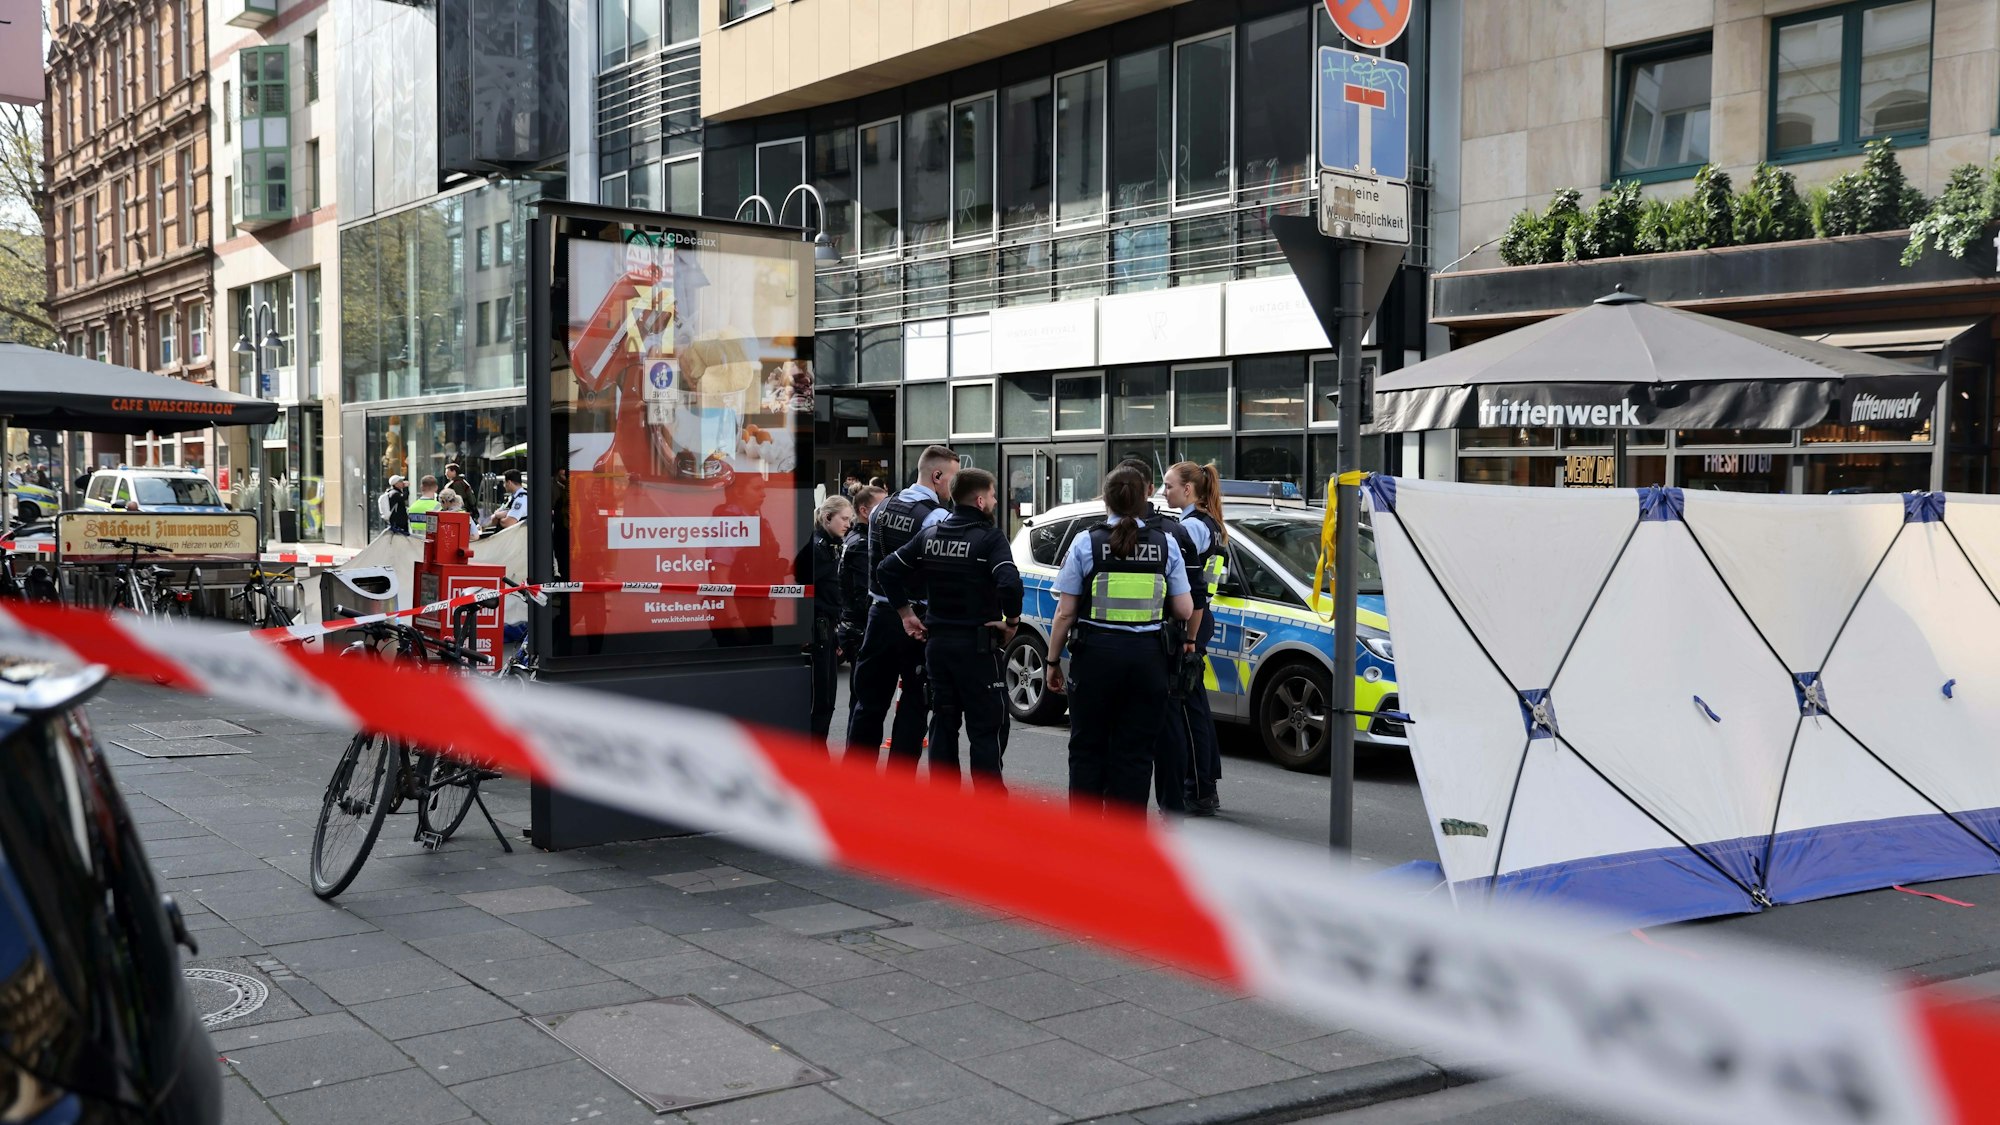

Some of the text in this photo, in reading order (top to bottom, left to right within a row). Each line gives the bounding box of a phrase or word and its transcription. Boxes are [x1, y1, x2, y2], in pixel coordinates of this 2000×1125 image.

[661, 232, 716, 247] JCDecaux
[1249, 301, 1292, 313] VINTAGE
[112, 399, 234, 415] CAFE WASCHSALON
[1479, 398, 1640, 426] frittenwerk
[1850, 391, 1921, 422] frittenwerk
[1596, 456, 1615, 484] DA
[1704, 454, 1739, 473] FRESH
[100, 520, 229, 539] Bäckerei Zimmermann
[875, 511, 915, 532] POLIZEI
[620, 521, 750, 543] Unvergesslich
[181, 541, 208, 549] Herzen
[924, 539, 971, 558] POLIZEI
[1102, 543, 1162, 562] PIZEI
[655, 554, 716, 573] lecker.
[699, 585, 733, 593] POLIZEI
[771, 586, 803, 595] POLIZEI
[644, 600, 725, 613] KitchenAid
[651, 613, 716, 624] www.kitchenaid.de
